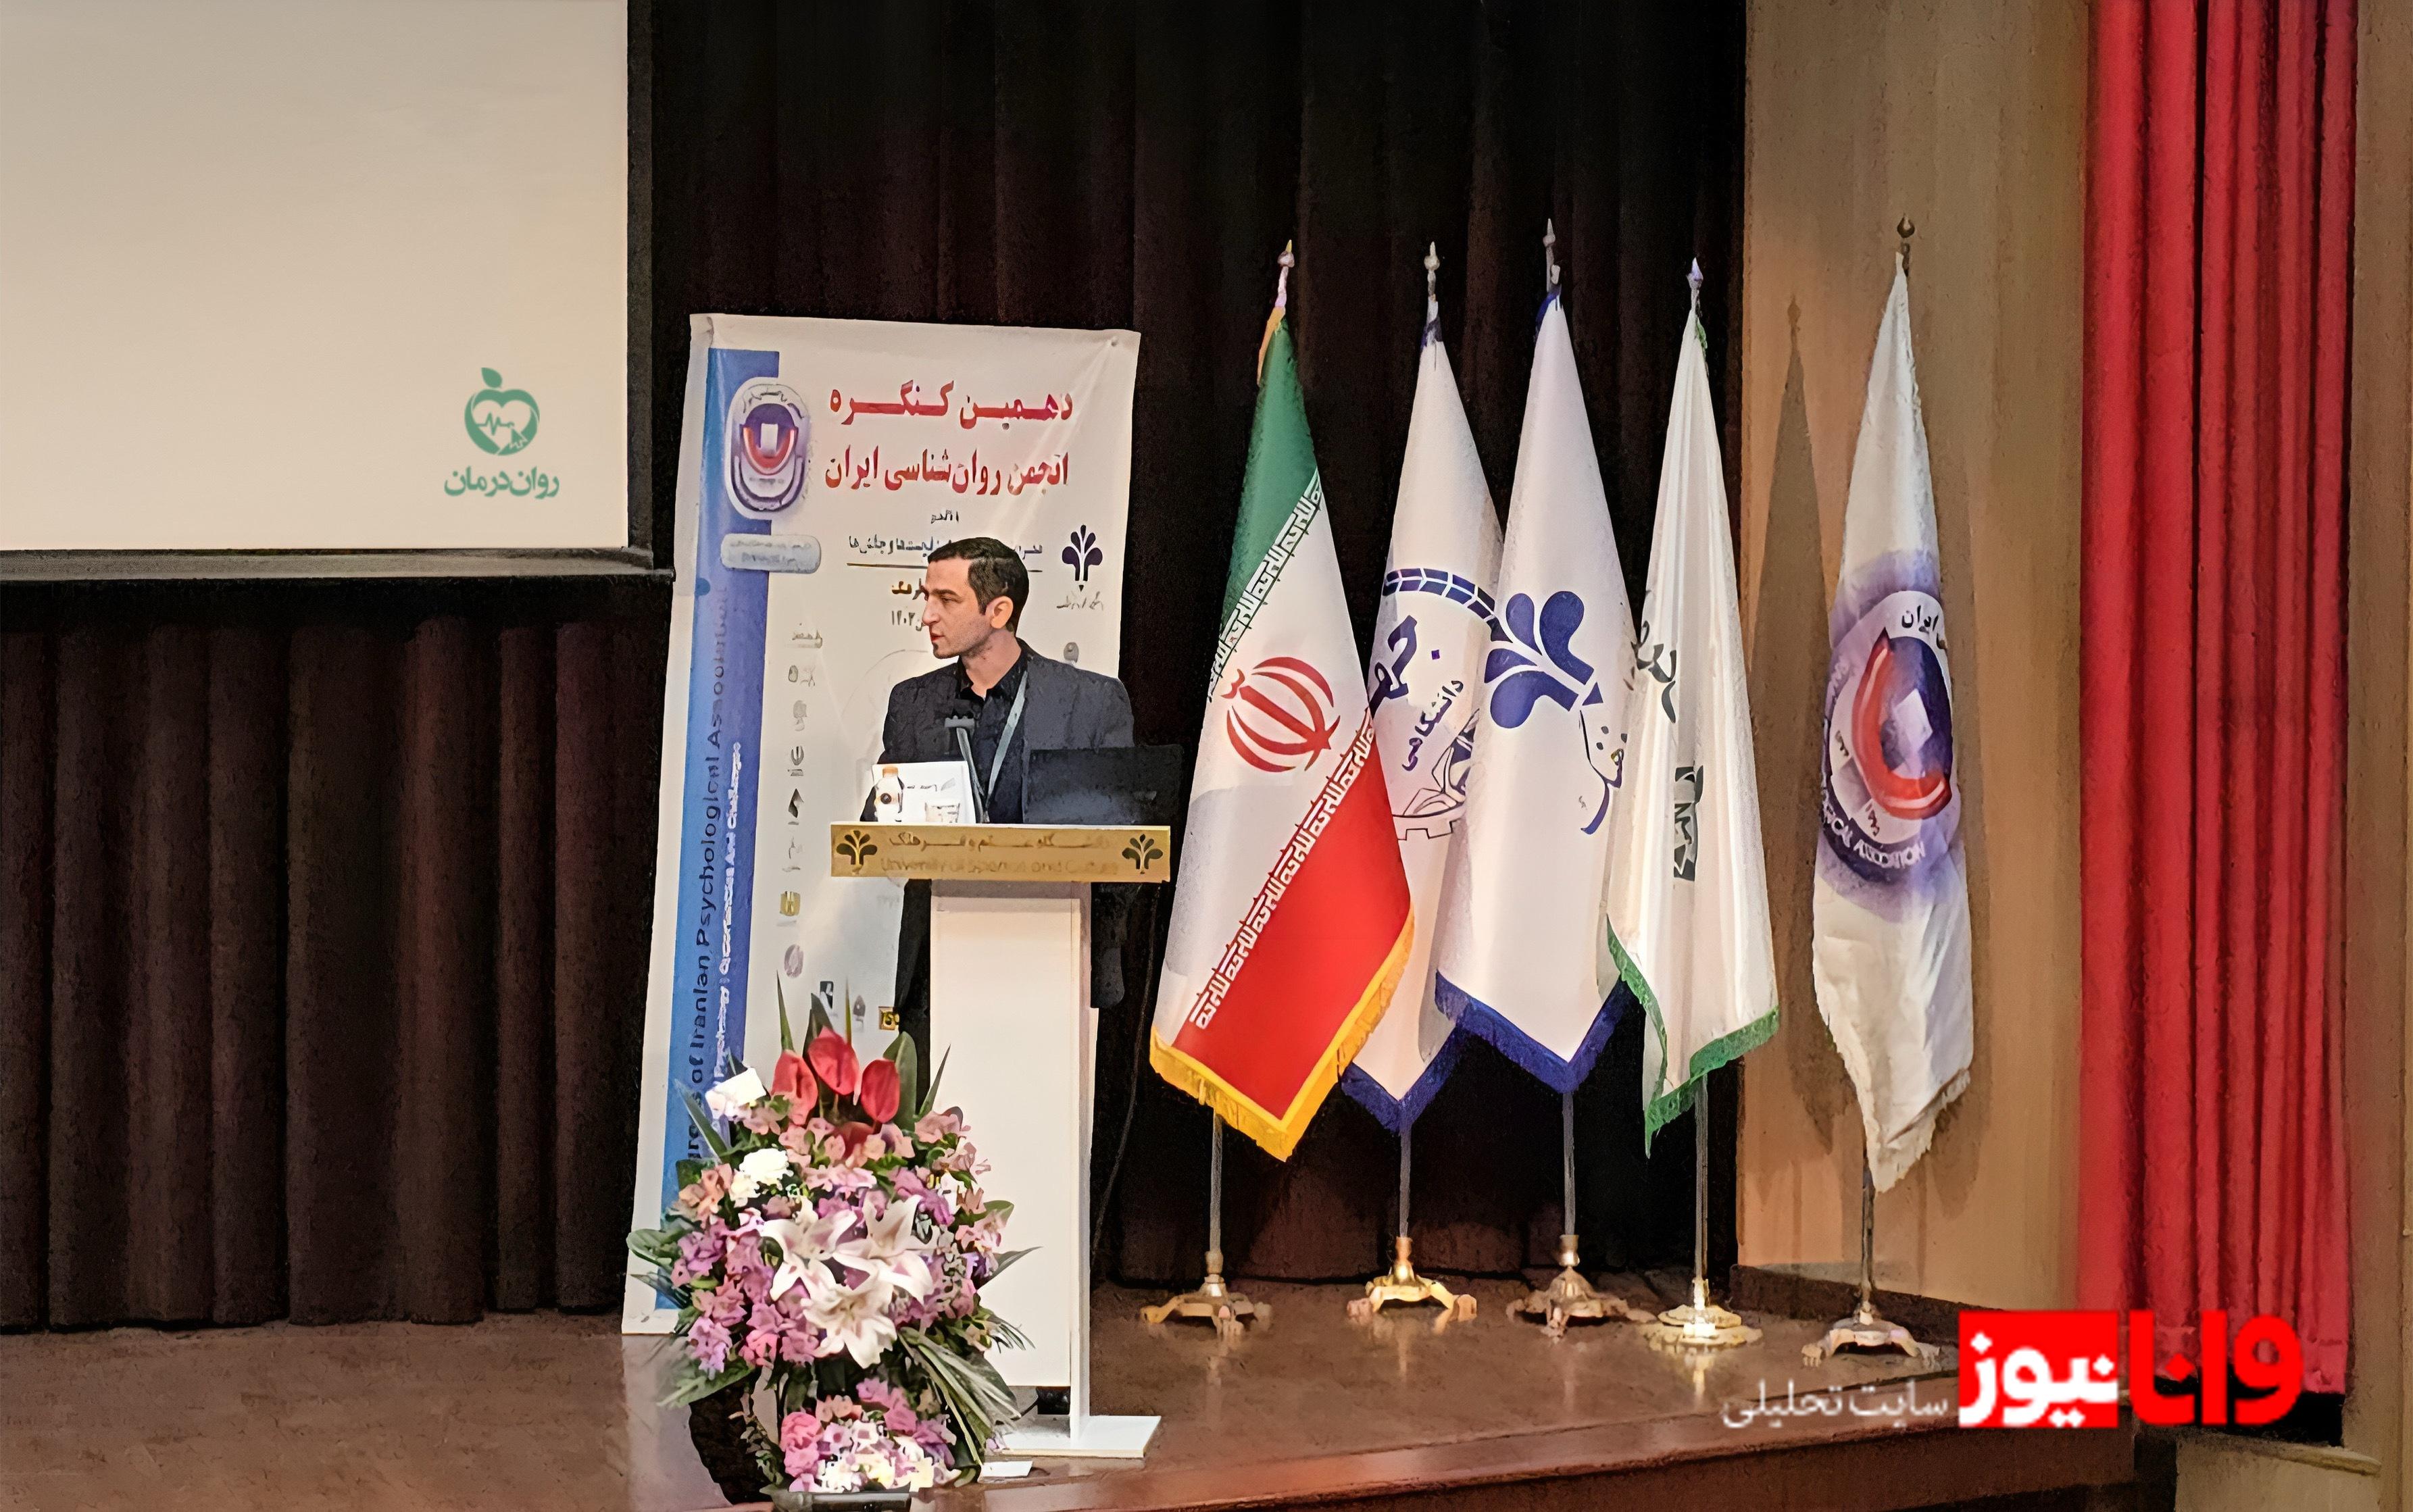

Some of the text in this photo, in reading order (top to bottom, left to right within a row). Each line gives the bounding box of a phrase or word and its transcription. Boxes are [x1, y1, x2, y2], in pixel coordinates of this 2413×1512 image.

[830, 379, 953, 426] کنگره
[960, 393, 1073, 429] دهمین
[825, 444, 878, 490] ایران
[1008, 451, 1069, 496] انجمن
